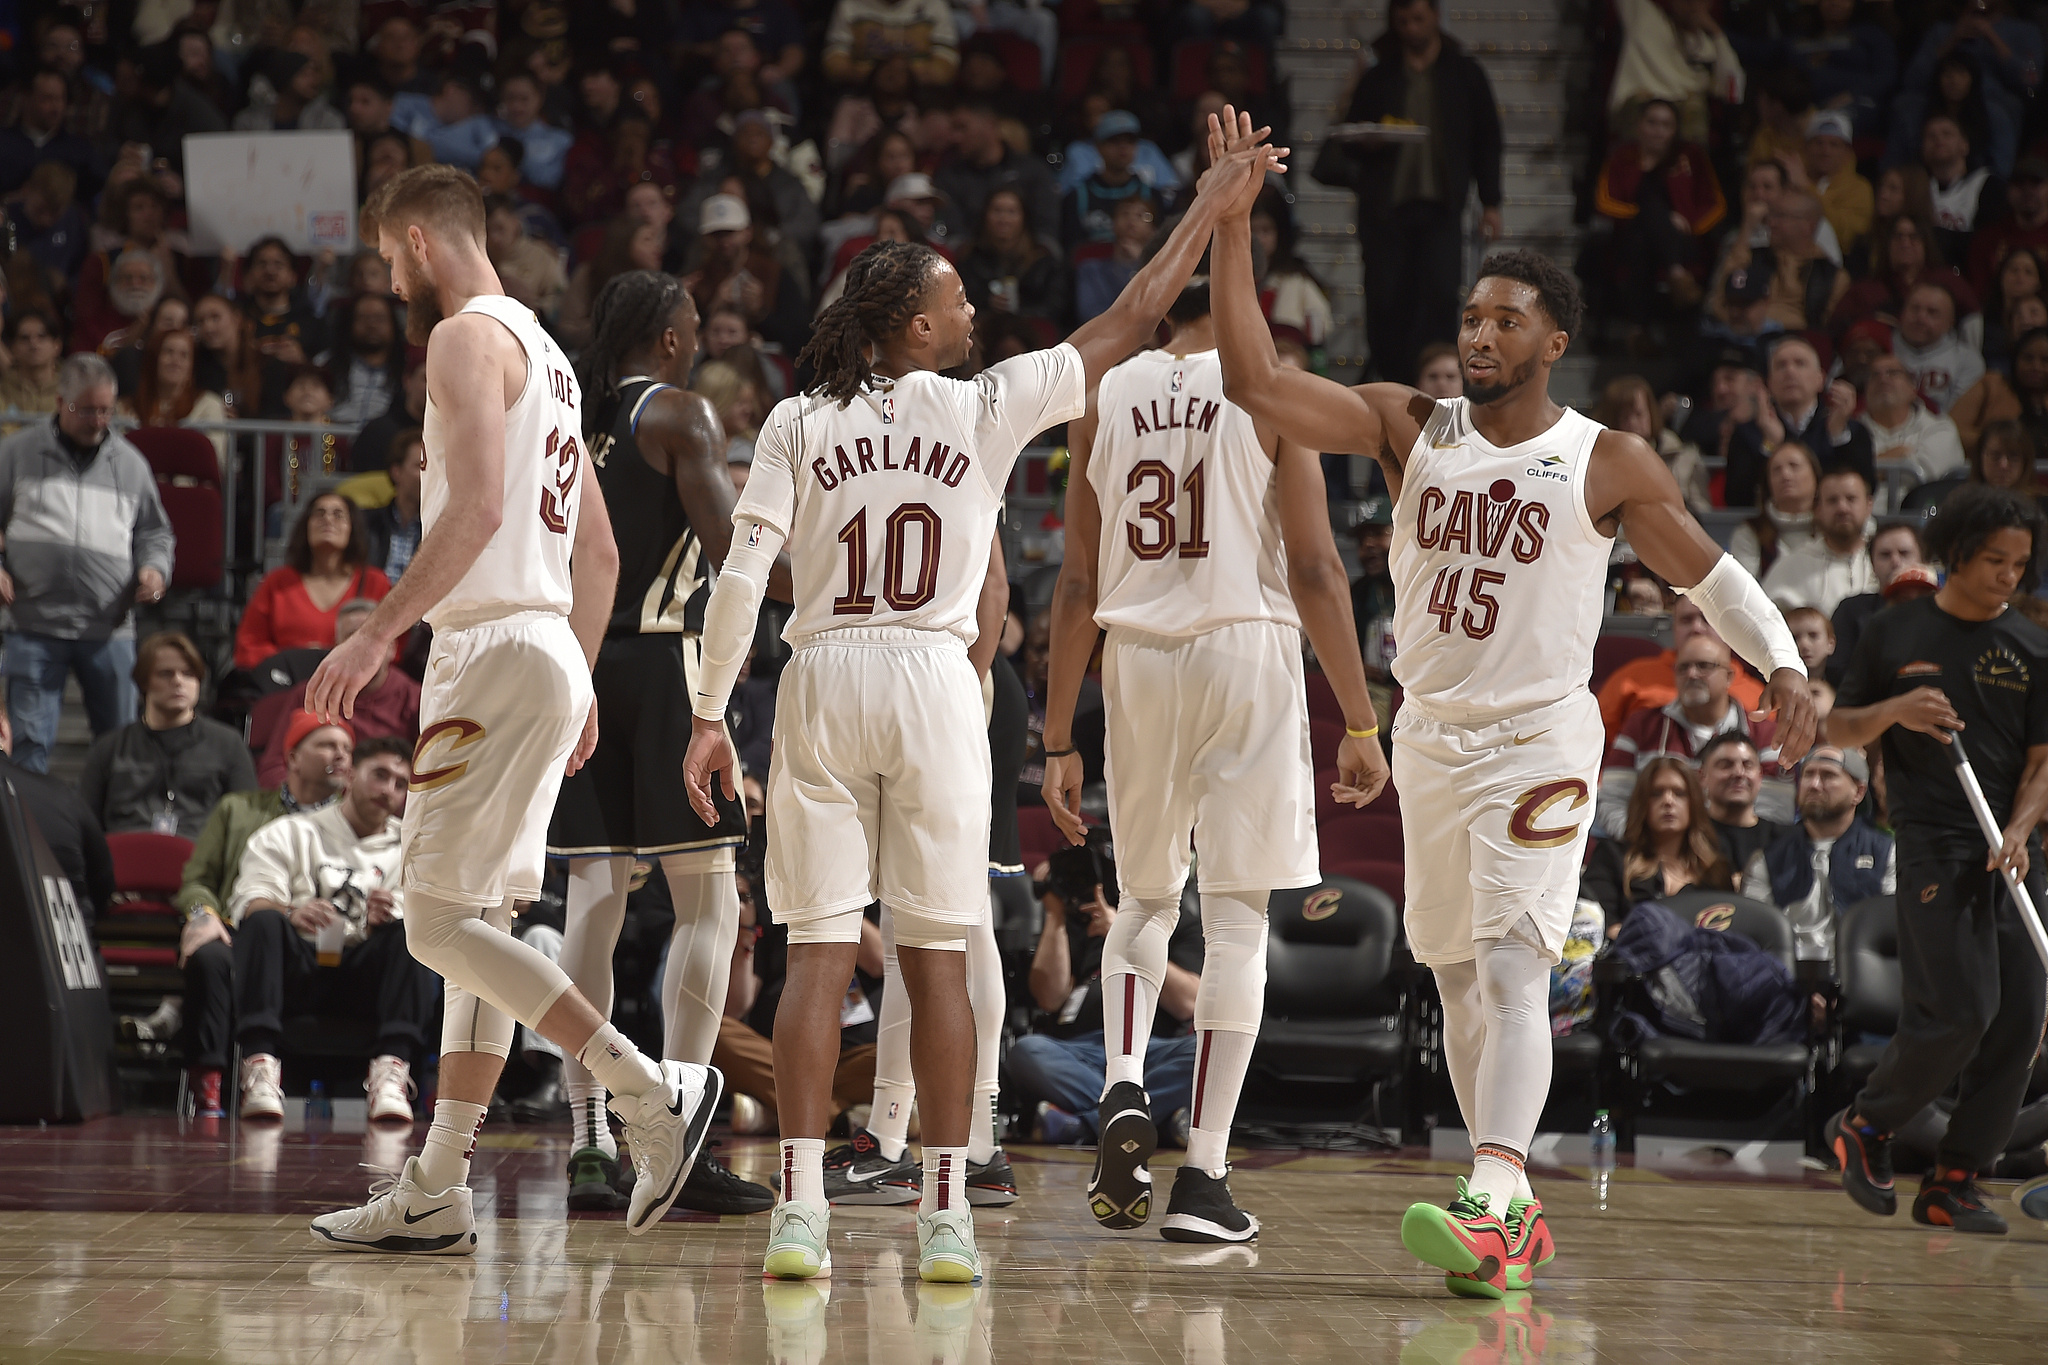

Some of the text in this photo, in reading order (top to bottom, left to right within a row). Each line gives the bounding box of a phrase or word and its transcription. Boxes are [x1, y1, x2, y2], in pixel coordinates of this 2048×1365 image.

[1131, 397, 1220, 438] ALLEN
[811, 434, 971, 492] GARLAND
[1526, 468, 1568, 482] CLIFFS
[1125, 457, 1210, 561] 31
[1416, 480, 1551, 565] CAVS
[832, 502, 942, 616] 10
[1427, 565, 1507, 641] 45
